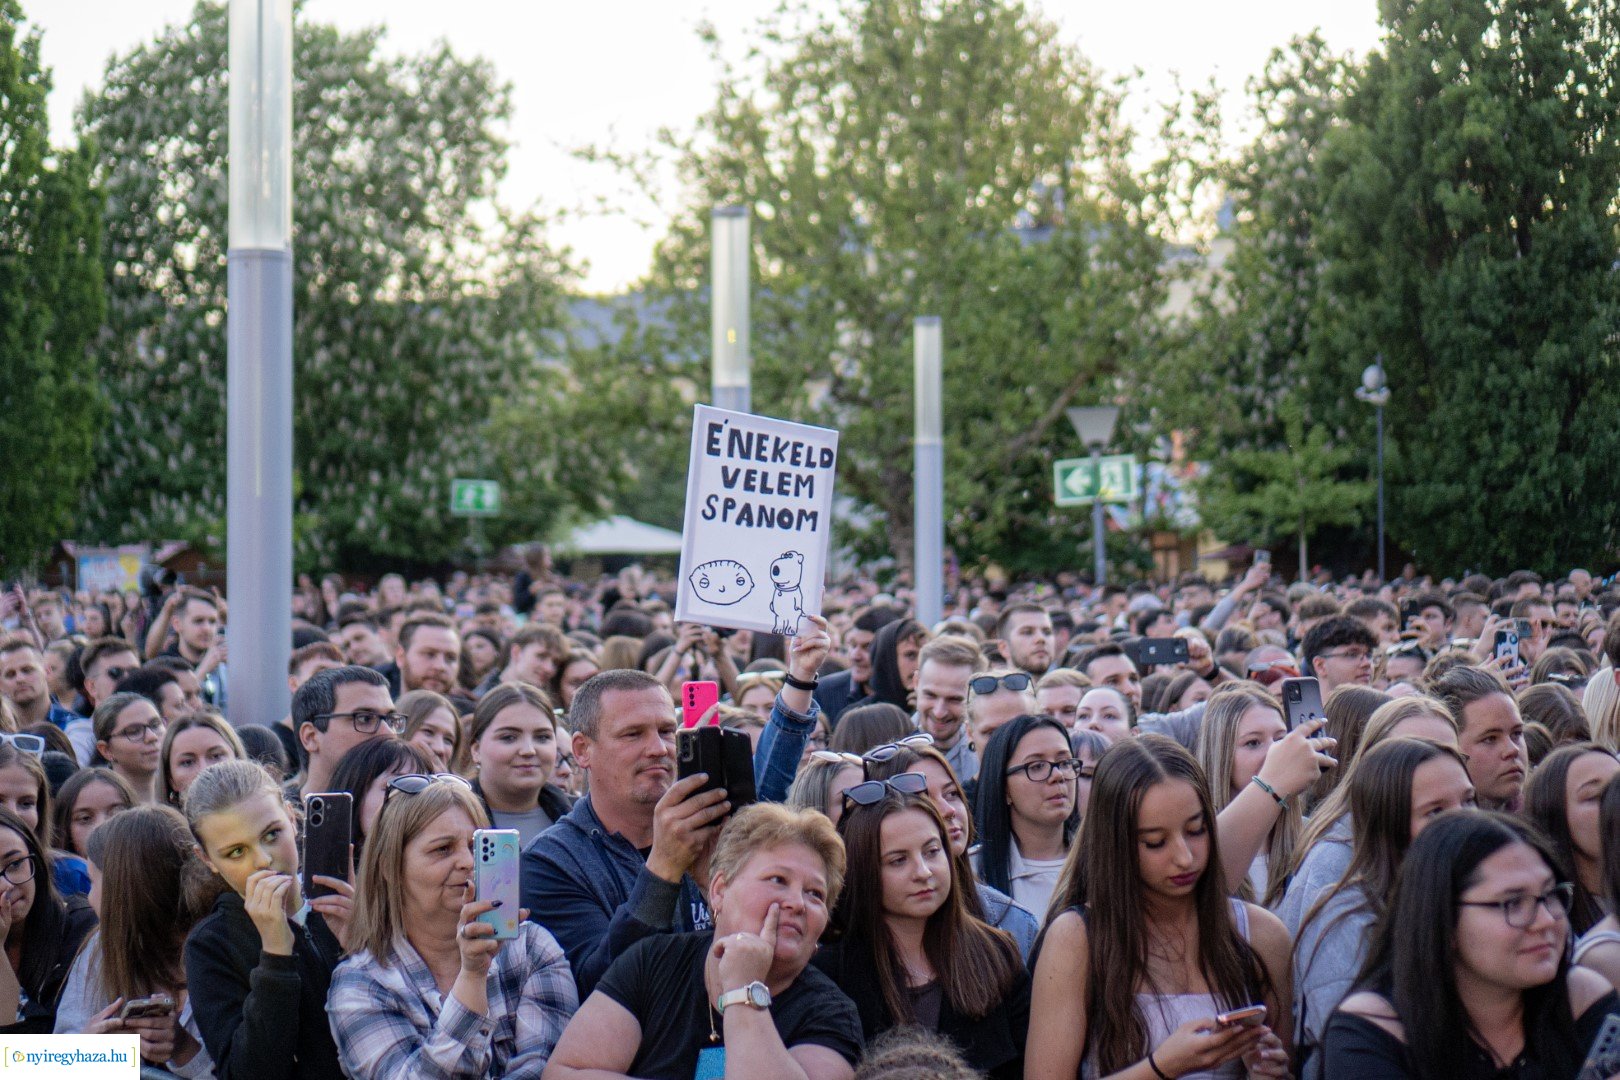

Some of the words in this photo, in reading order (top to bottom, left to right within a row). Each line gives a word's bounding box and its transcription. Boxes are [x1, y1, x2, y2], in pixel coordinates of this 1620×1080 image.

[706, 419, 834, 469] ÉNEKELD
[721, 465, 815, 499] VELEM
[701, 493, 818, 532] SPANOM
